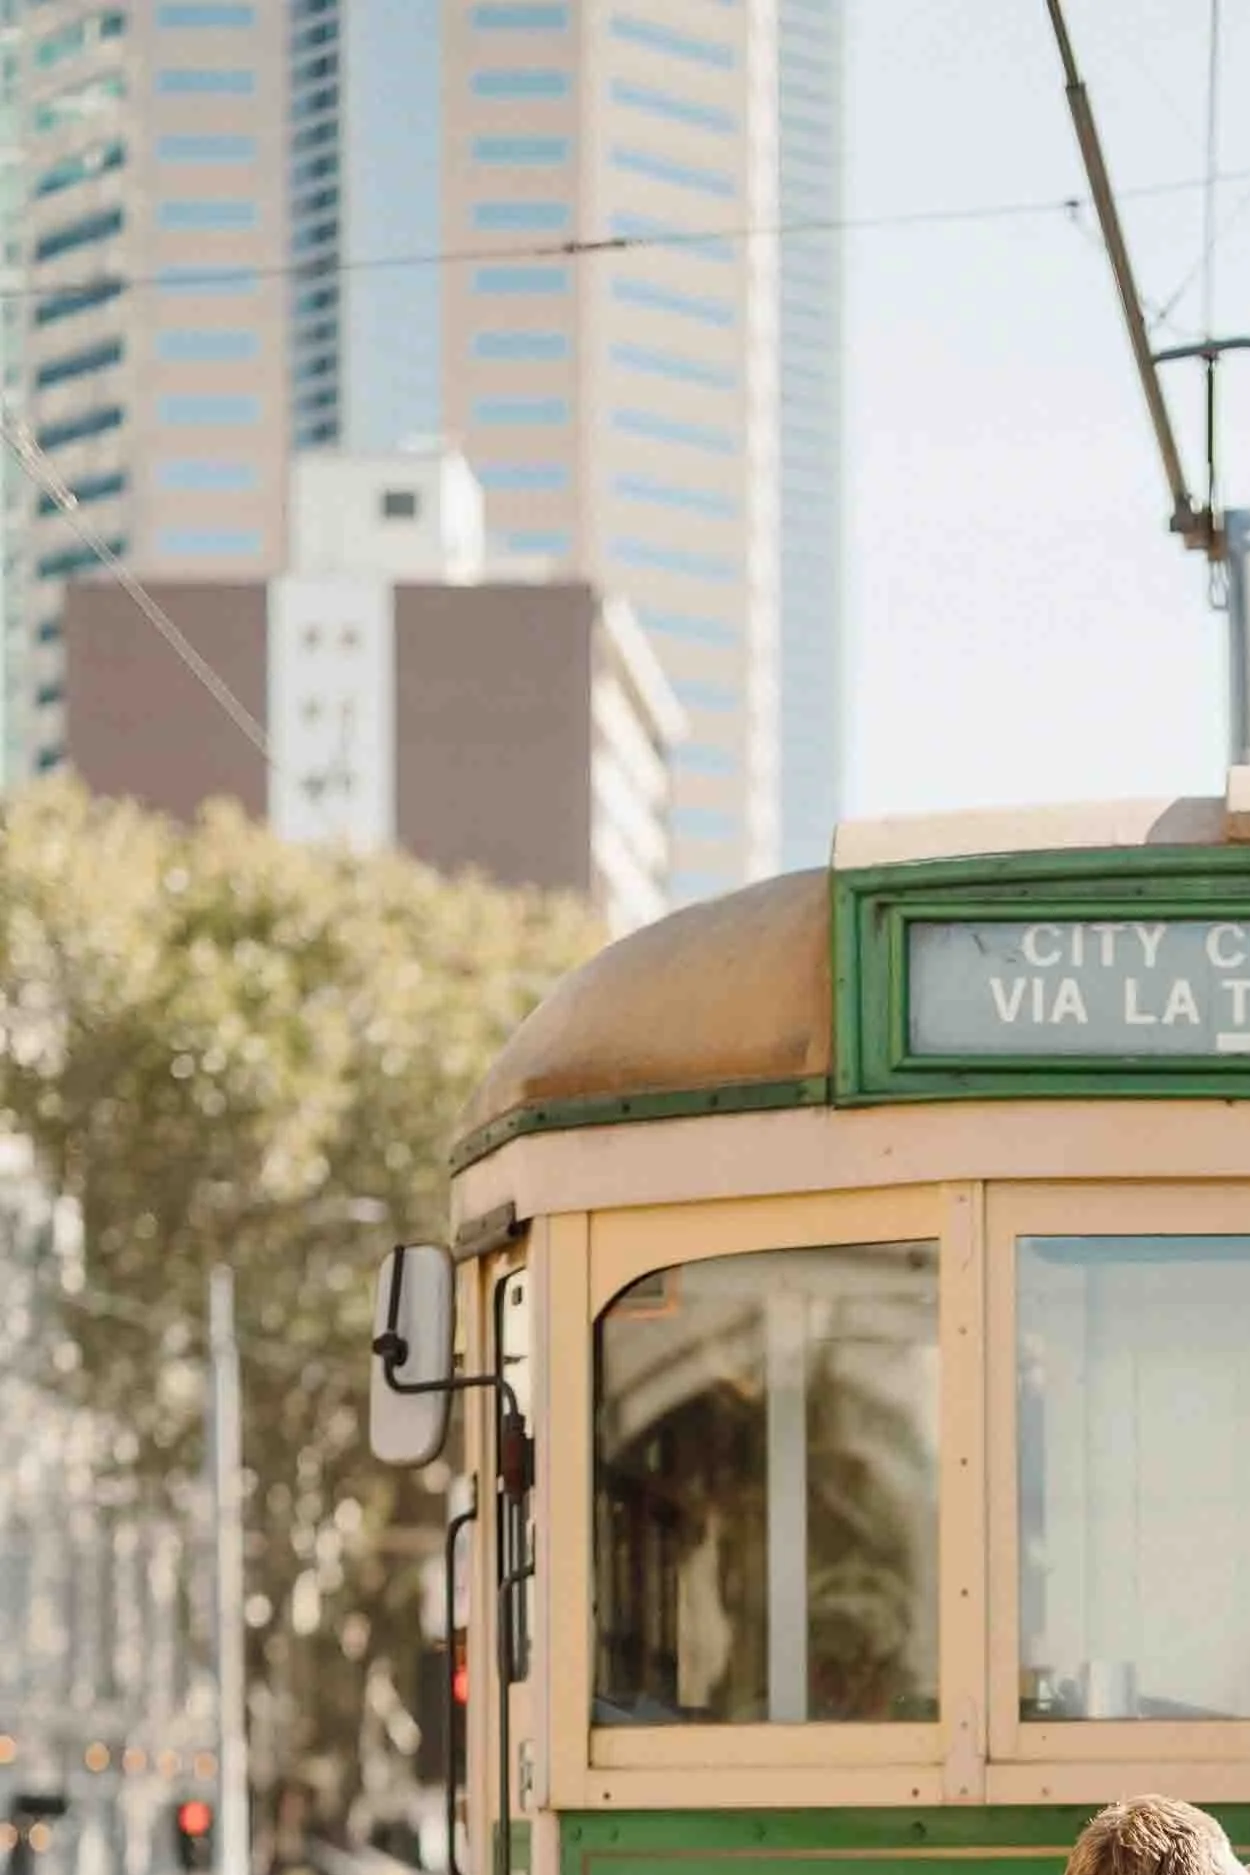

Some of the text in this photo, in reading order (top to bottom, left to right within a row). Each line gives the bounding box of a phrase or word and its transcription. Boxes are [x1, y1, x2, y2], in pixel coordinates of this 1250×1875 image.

[1021, 923, 1167, 968] CITY
[989, 977, 1089, 1025] VIA
[1124, 977, 1201, 1025] LA
